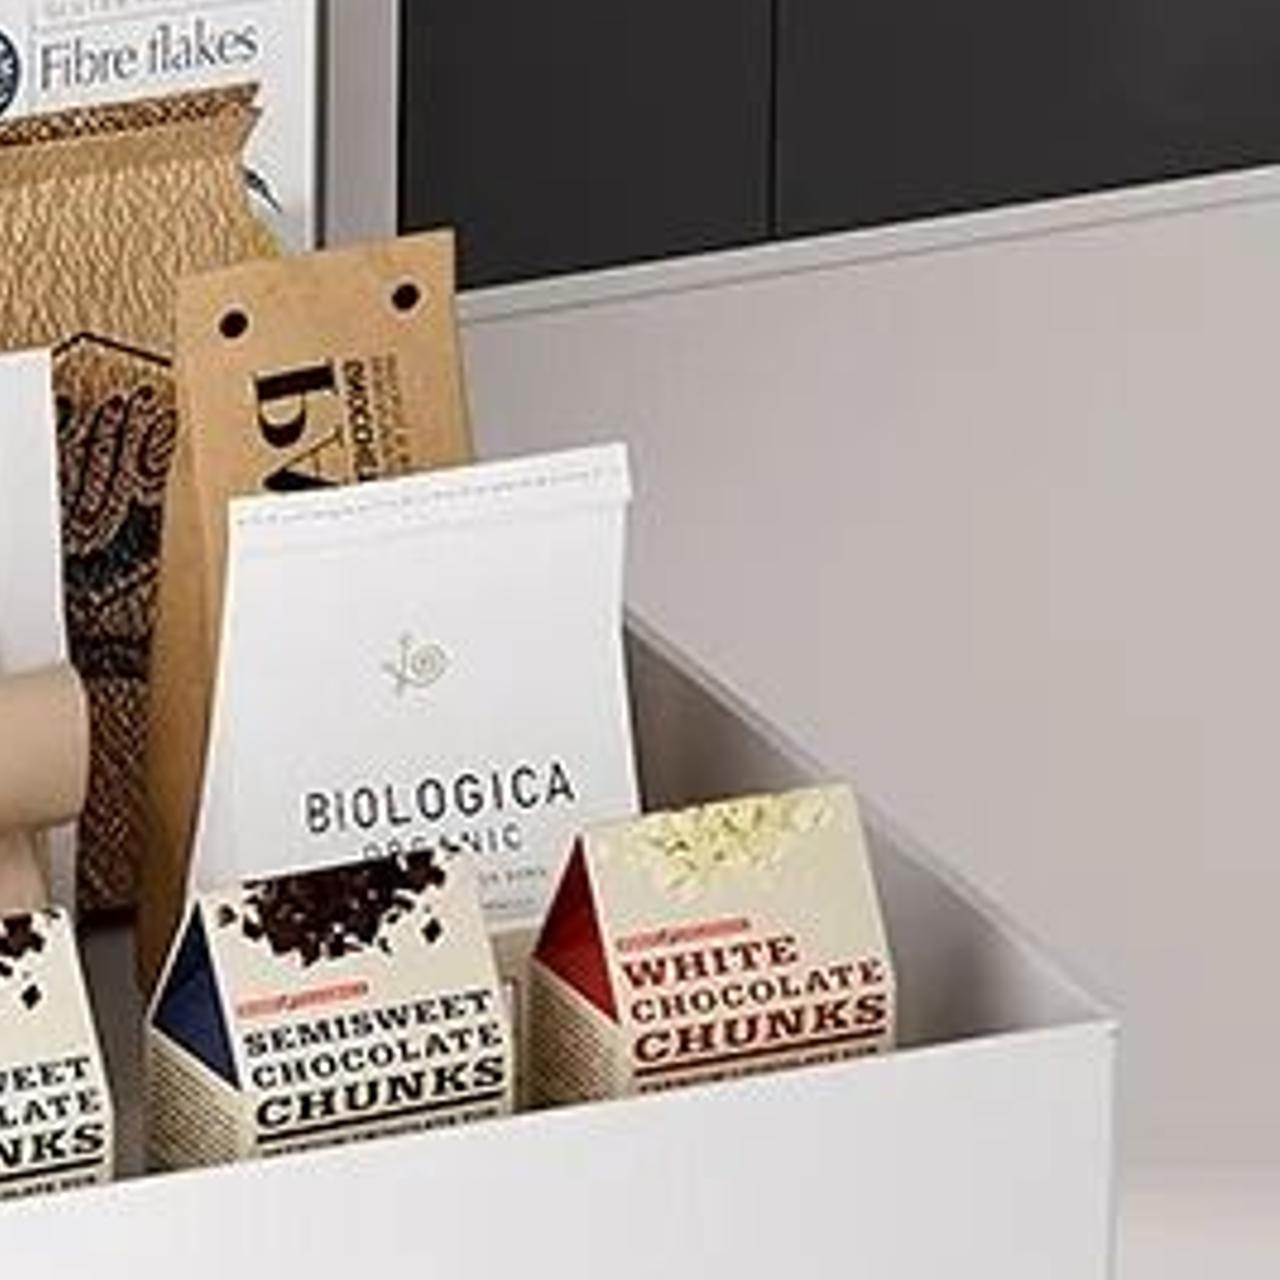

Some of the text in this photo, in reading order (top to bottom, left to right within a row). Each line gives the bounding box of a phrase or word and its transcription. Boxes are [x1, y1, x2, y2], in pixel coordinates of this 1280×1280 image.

[41, 18, 258, 90] Fibre flakes
[305, 762, 575, 834] BIOLOGICA
[622, 935, 797, 989] WHITE
[630, 957, 884, 1023] CHOCOLATE
[243, 988, 492, 1058] SEMISWEET
[251, 1022, 503, 1091] CHOCOLATE
[633, 993, 887, 1063] CHUNKS
[256, 1056, 504, 1128] CHUNKS
